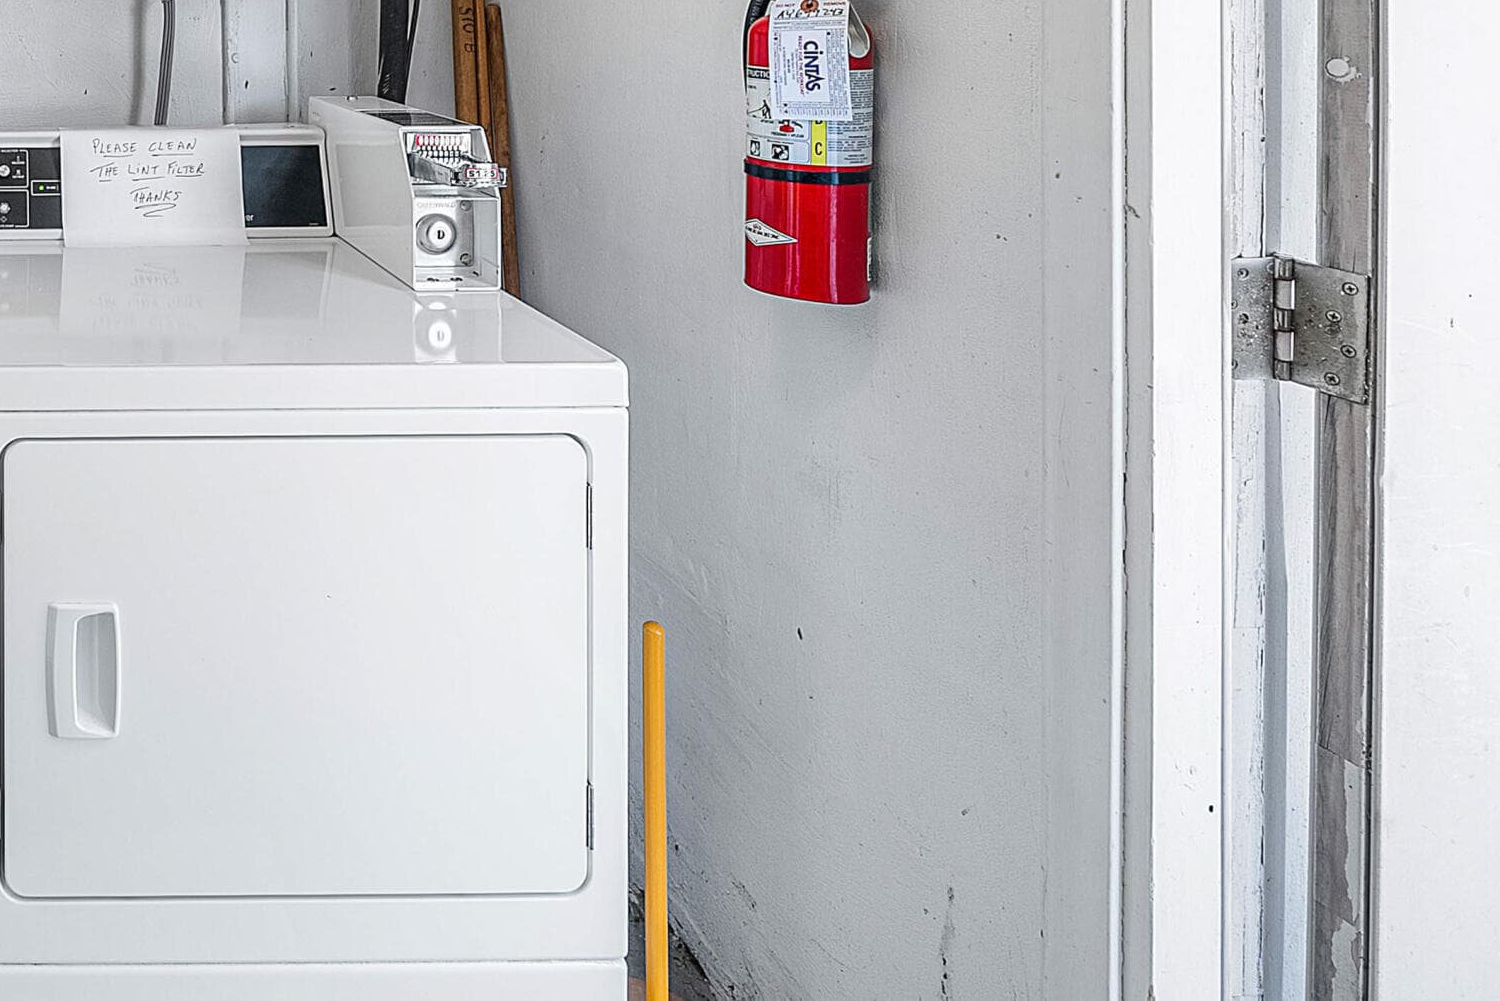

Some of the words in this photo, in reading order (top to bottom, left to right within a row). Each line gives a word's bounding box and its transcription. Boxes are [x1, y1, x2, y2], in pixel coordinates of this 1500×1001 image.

[92, 138, 137, 154] PLEASE
[148, 138, 197, 151] CLEAN
[815, 142, 822, 155] C
[90, 162, 118, 177] THE
[130, 187, 182, 203] THANKS
